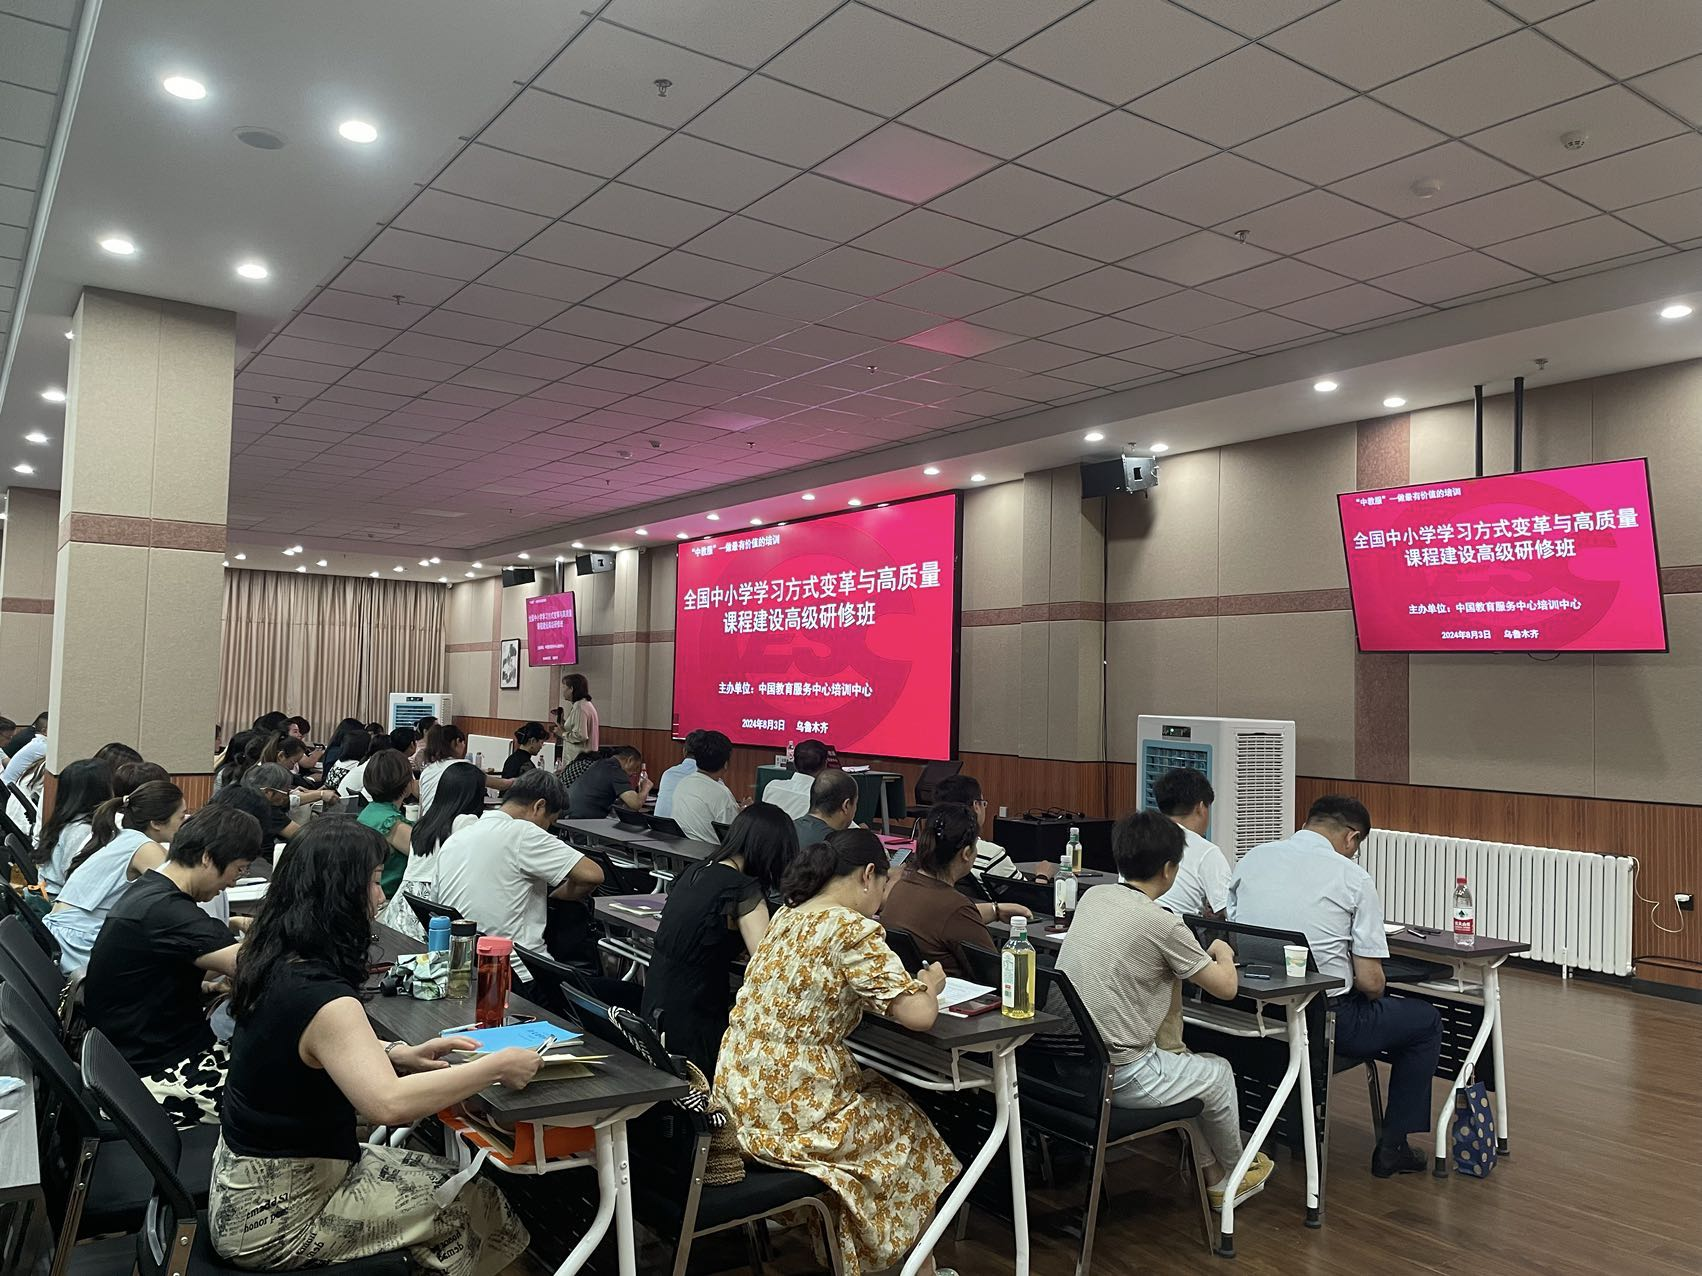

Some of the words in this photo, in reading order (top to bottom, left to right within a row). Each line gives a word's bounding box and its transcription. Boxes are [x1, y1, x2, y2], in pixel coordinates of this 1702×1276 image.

[1353, 508, 1639, 550] 全国中小学学习方式变革与高质量
[1404, 538, 1576, 567] 课程建设高级研修班
[683, 561, 941, 611] 全国中小学学习方式变革与高质量
[722, 601, 876, 634] 课程建设高级研修班
[1441, 630, 1491, 640] 2024年8月3日
[1504, 629, 1539, 639] 乌鲁木齐
[741, 718, 786, 731] 2024年8月3日
[796, 720, 829, 734] 乌鲁木齐
